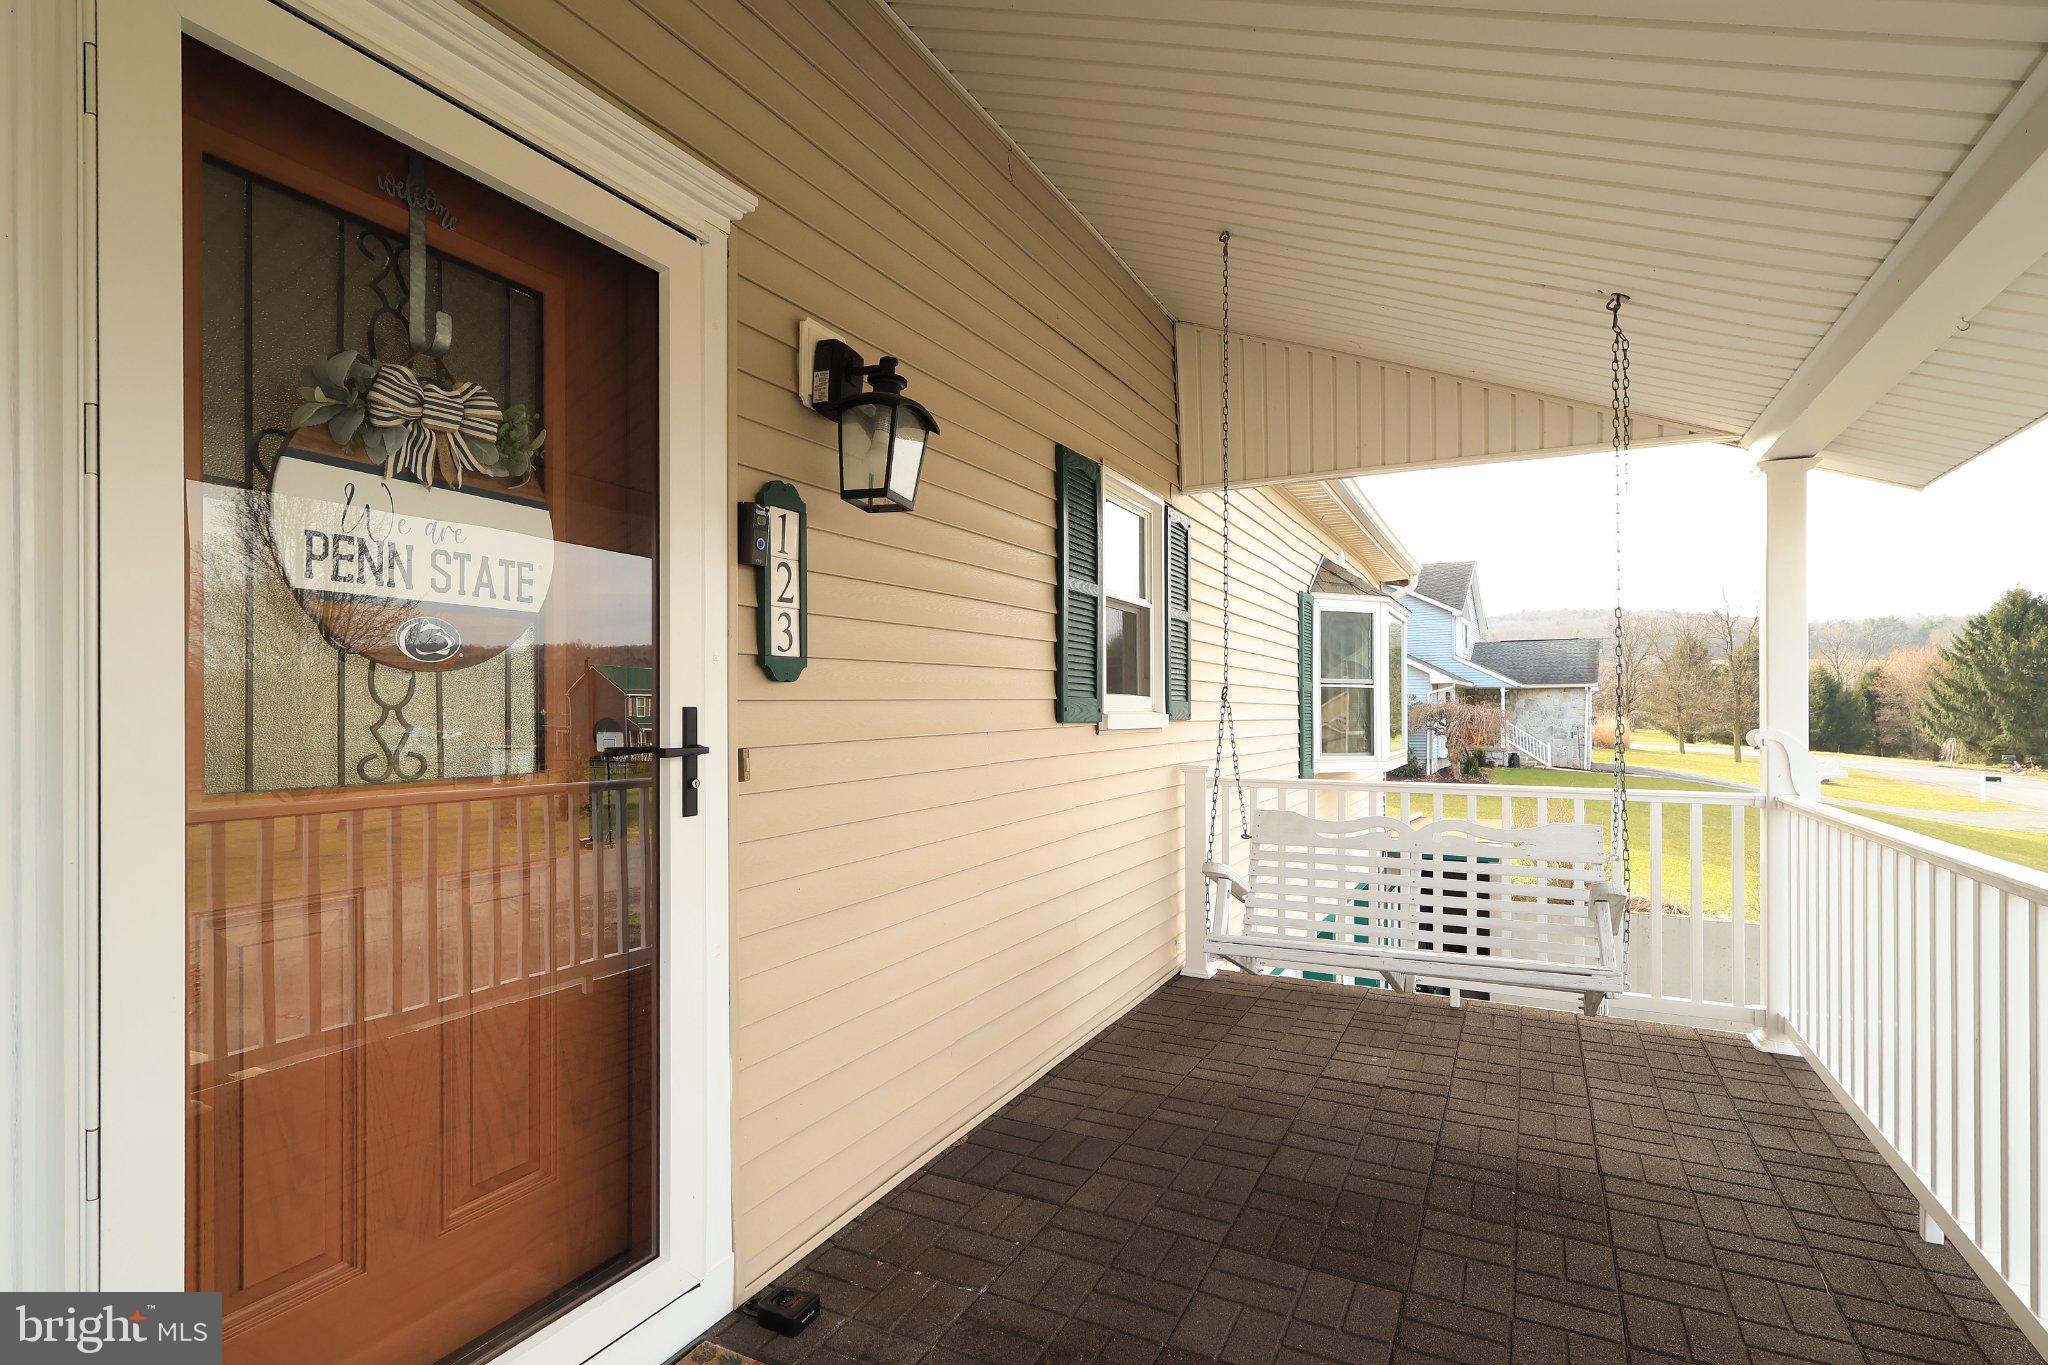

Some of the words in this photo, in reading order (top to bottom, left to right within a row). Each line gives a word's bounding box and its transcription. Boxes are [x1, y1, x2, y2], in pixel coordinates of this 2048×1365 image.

[341, 482, 412, 543] We
[424, 518, 469, 545] are
[304, 529, 414, 590] PENN
[430, 548, 534, 604] STATE
